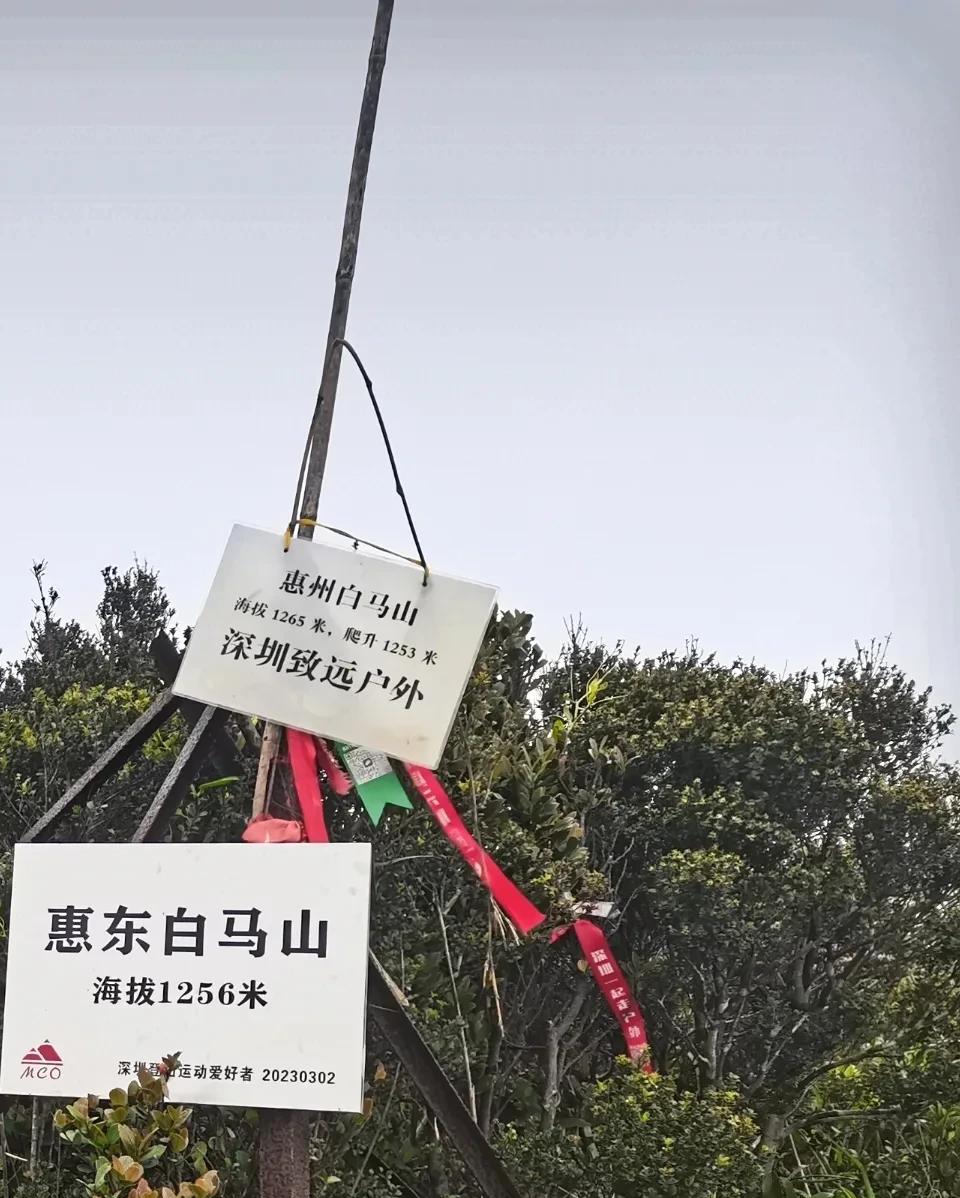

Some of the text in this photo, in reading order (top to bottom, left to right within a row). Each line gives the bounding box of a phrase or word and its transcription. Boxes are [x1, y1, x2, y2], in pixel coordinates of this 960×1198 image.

[278, 569, 419, 627] 惠州白马山
[221, 627, 424, 710] 深圳致远户外
[44, 904, 329, 959] 惠东白马山
[92, 975, 269, 1010] 海拔1256米
[20, 1066, 61, 1080] MCO
[262, 1068, 336, 1084] 20230302
